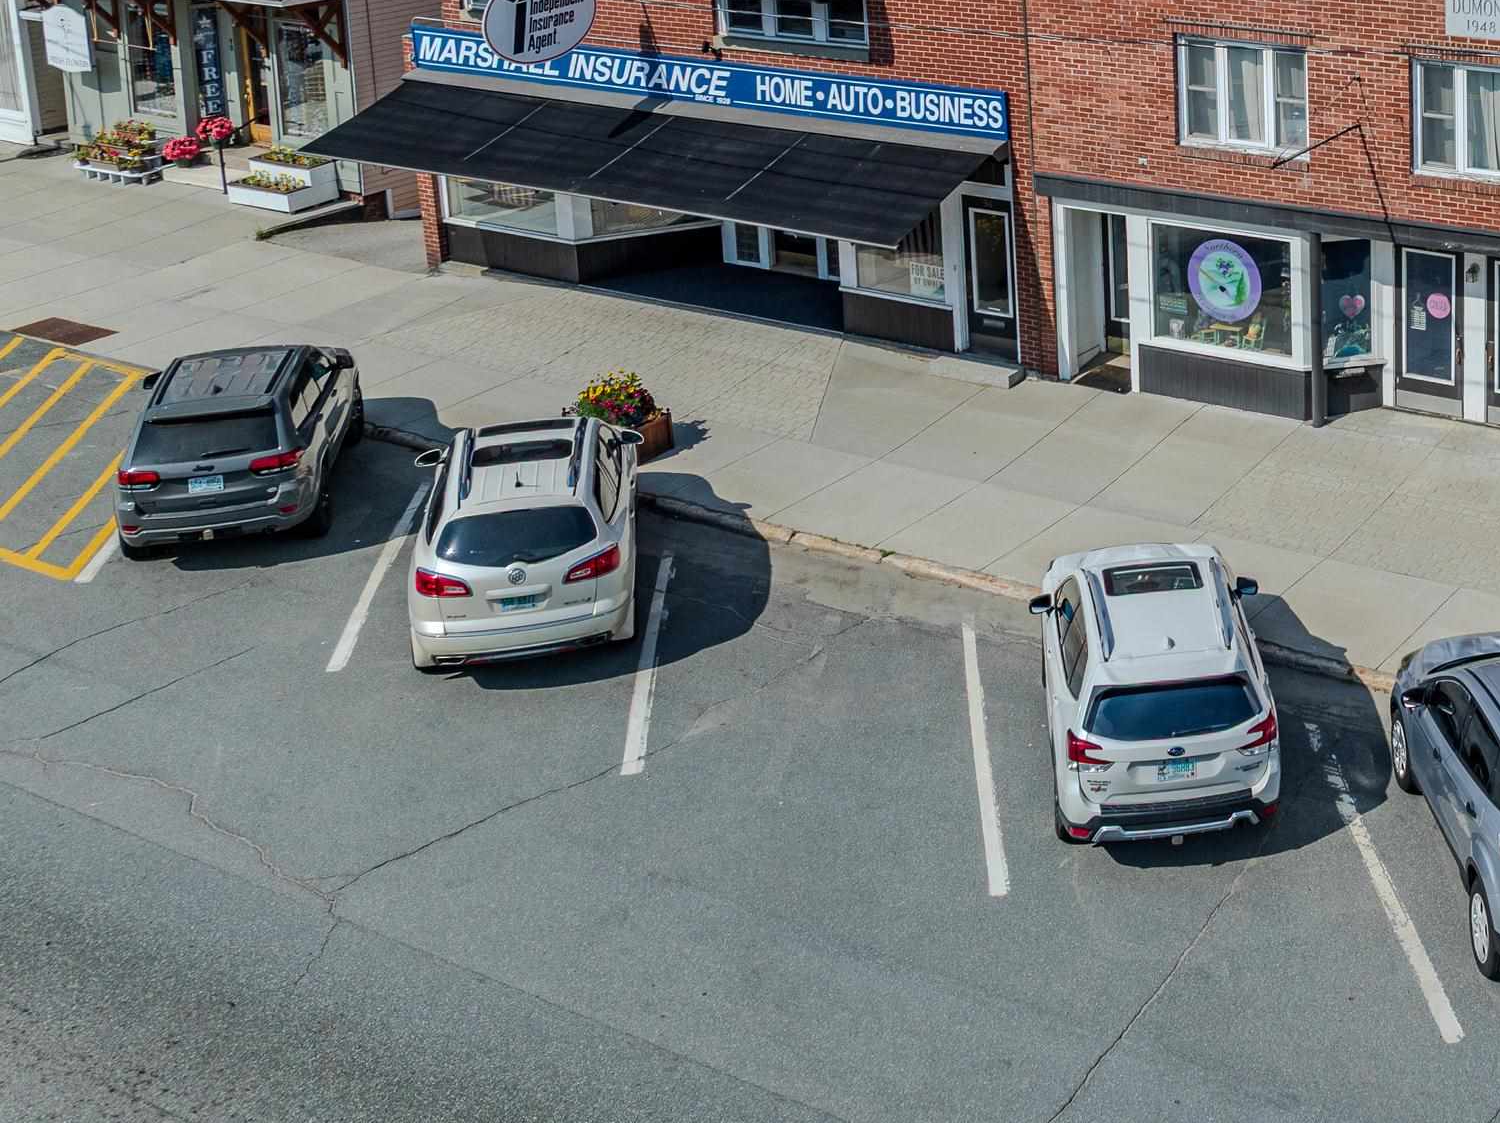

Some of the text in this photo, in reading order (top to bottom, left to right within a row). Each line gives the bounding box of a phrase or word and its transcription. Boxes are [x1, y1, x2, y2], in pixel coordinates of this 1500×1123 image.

[529, 9, 575, 34] Insurance
[1466, 19, 1497, 35] 1948
[528, 29, 558, 54] Agent
[200, 49, 222, 115] FREE
[568, 53, 731, 97] INSURANCE
[756, 75, 1003, 129] HOME AUTO BUSINESS
[911, 263, 944, 281] FOR SALE
